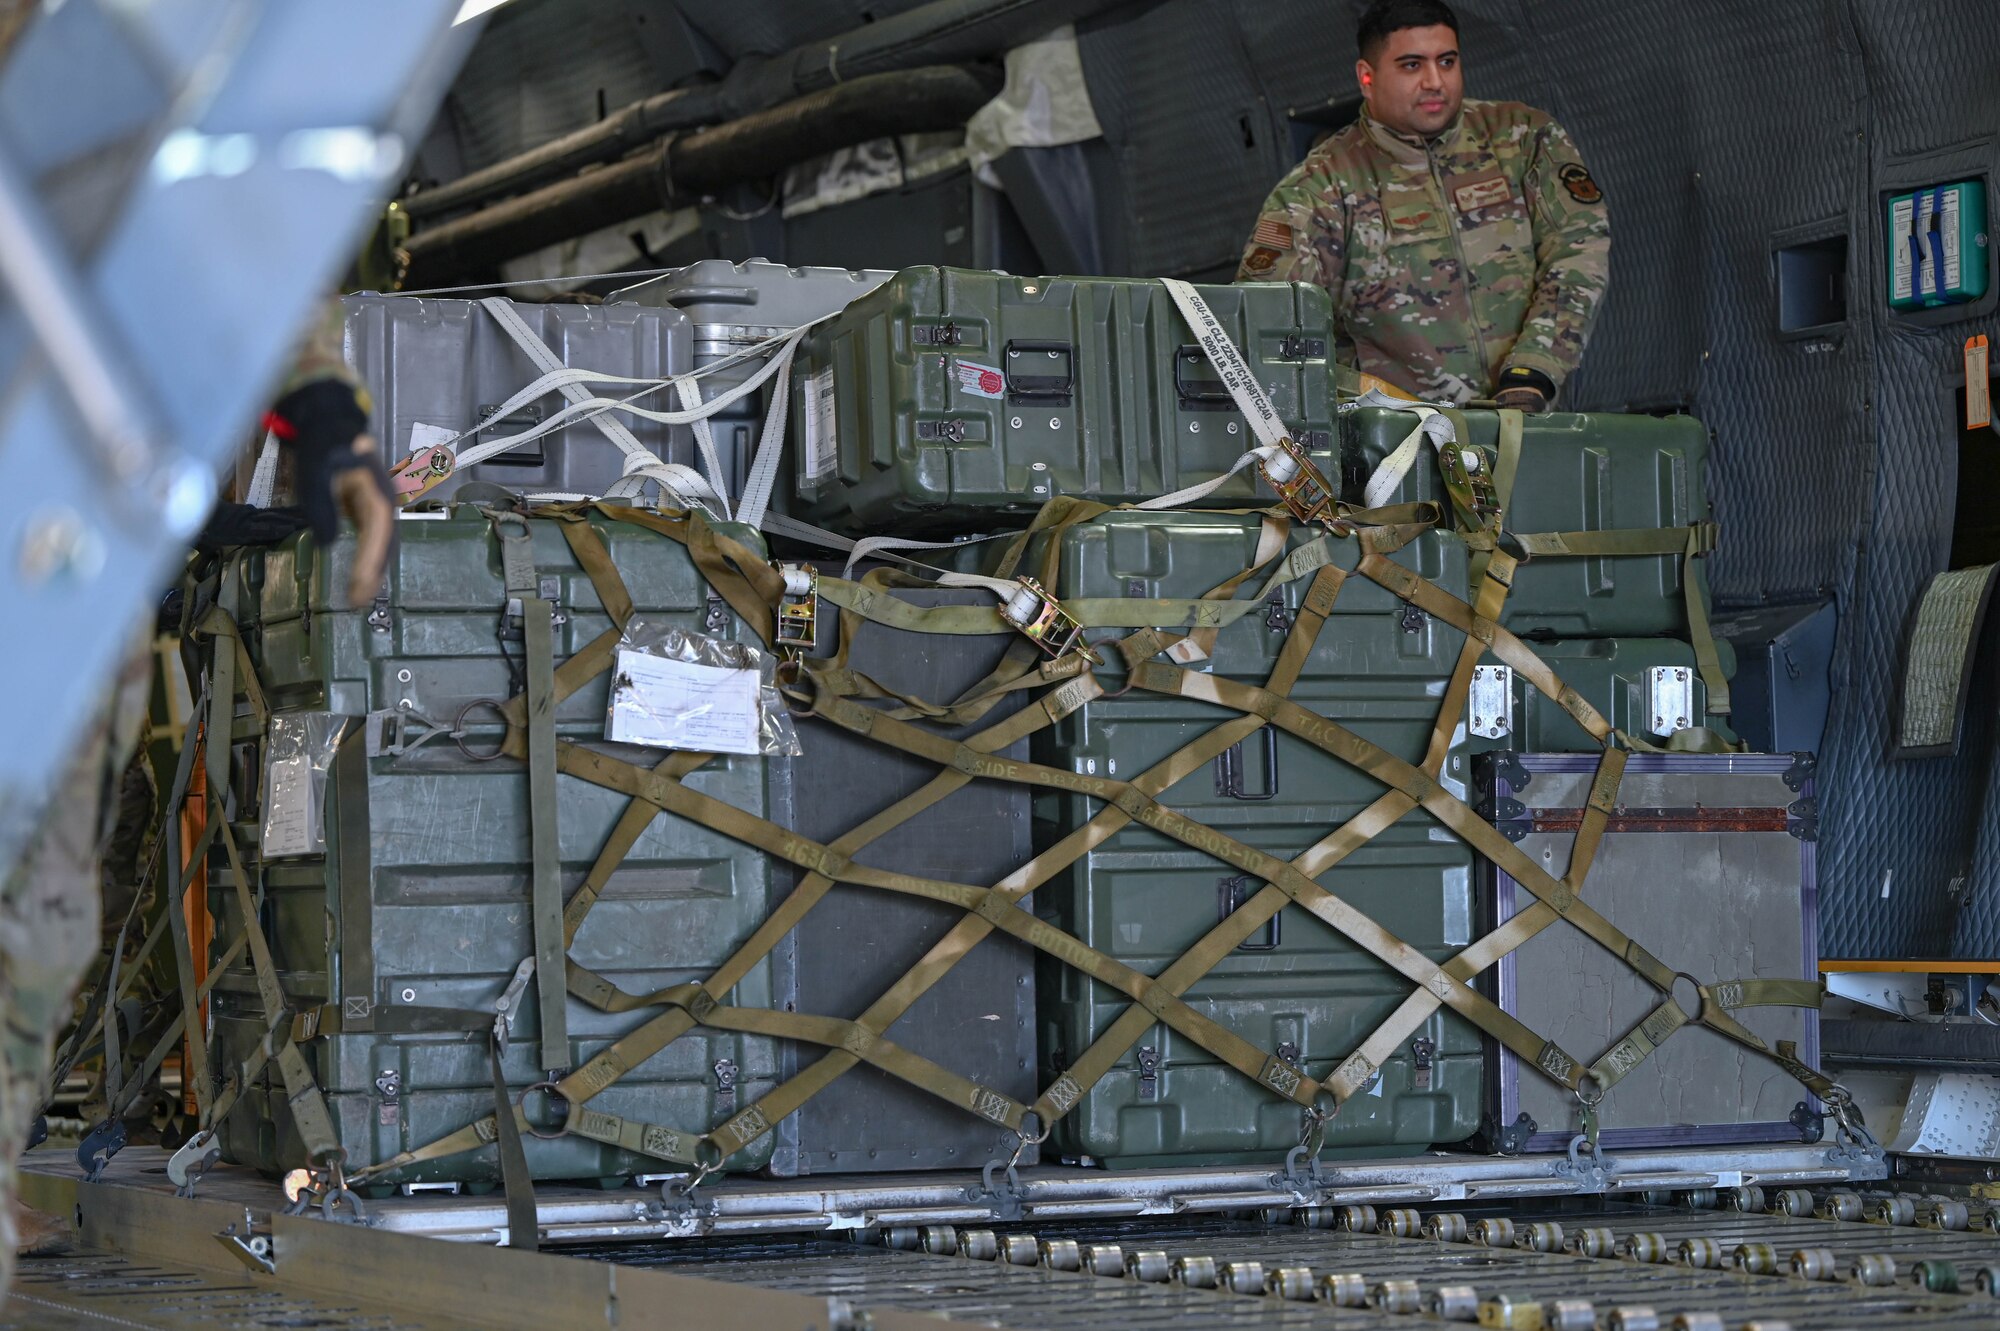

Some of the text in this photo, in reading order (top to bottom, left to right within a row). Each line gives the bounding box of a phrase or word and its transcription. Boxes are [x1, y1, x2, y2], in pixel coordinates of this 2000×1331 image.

[1190, 296, 1216, 327] CGU-1/B
[1211, 327, 1226, 344] CL2
[1202, 335, 1240, 391] 5000 LB. CAP.
[1298, 714, 1337, 744] TAC
[974, 759, 1018, 779] SIDE
[1040, 771, 1105, 796] 98752
[1029, 923, 1102, 973] BOTTOM
